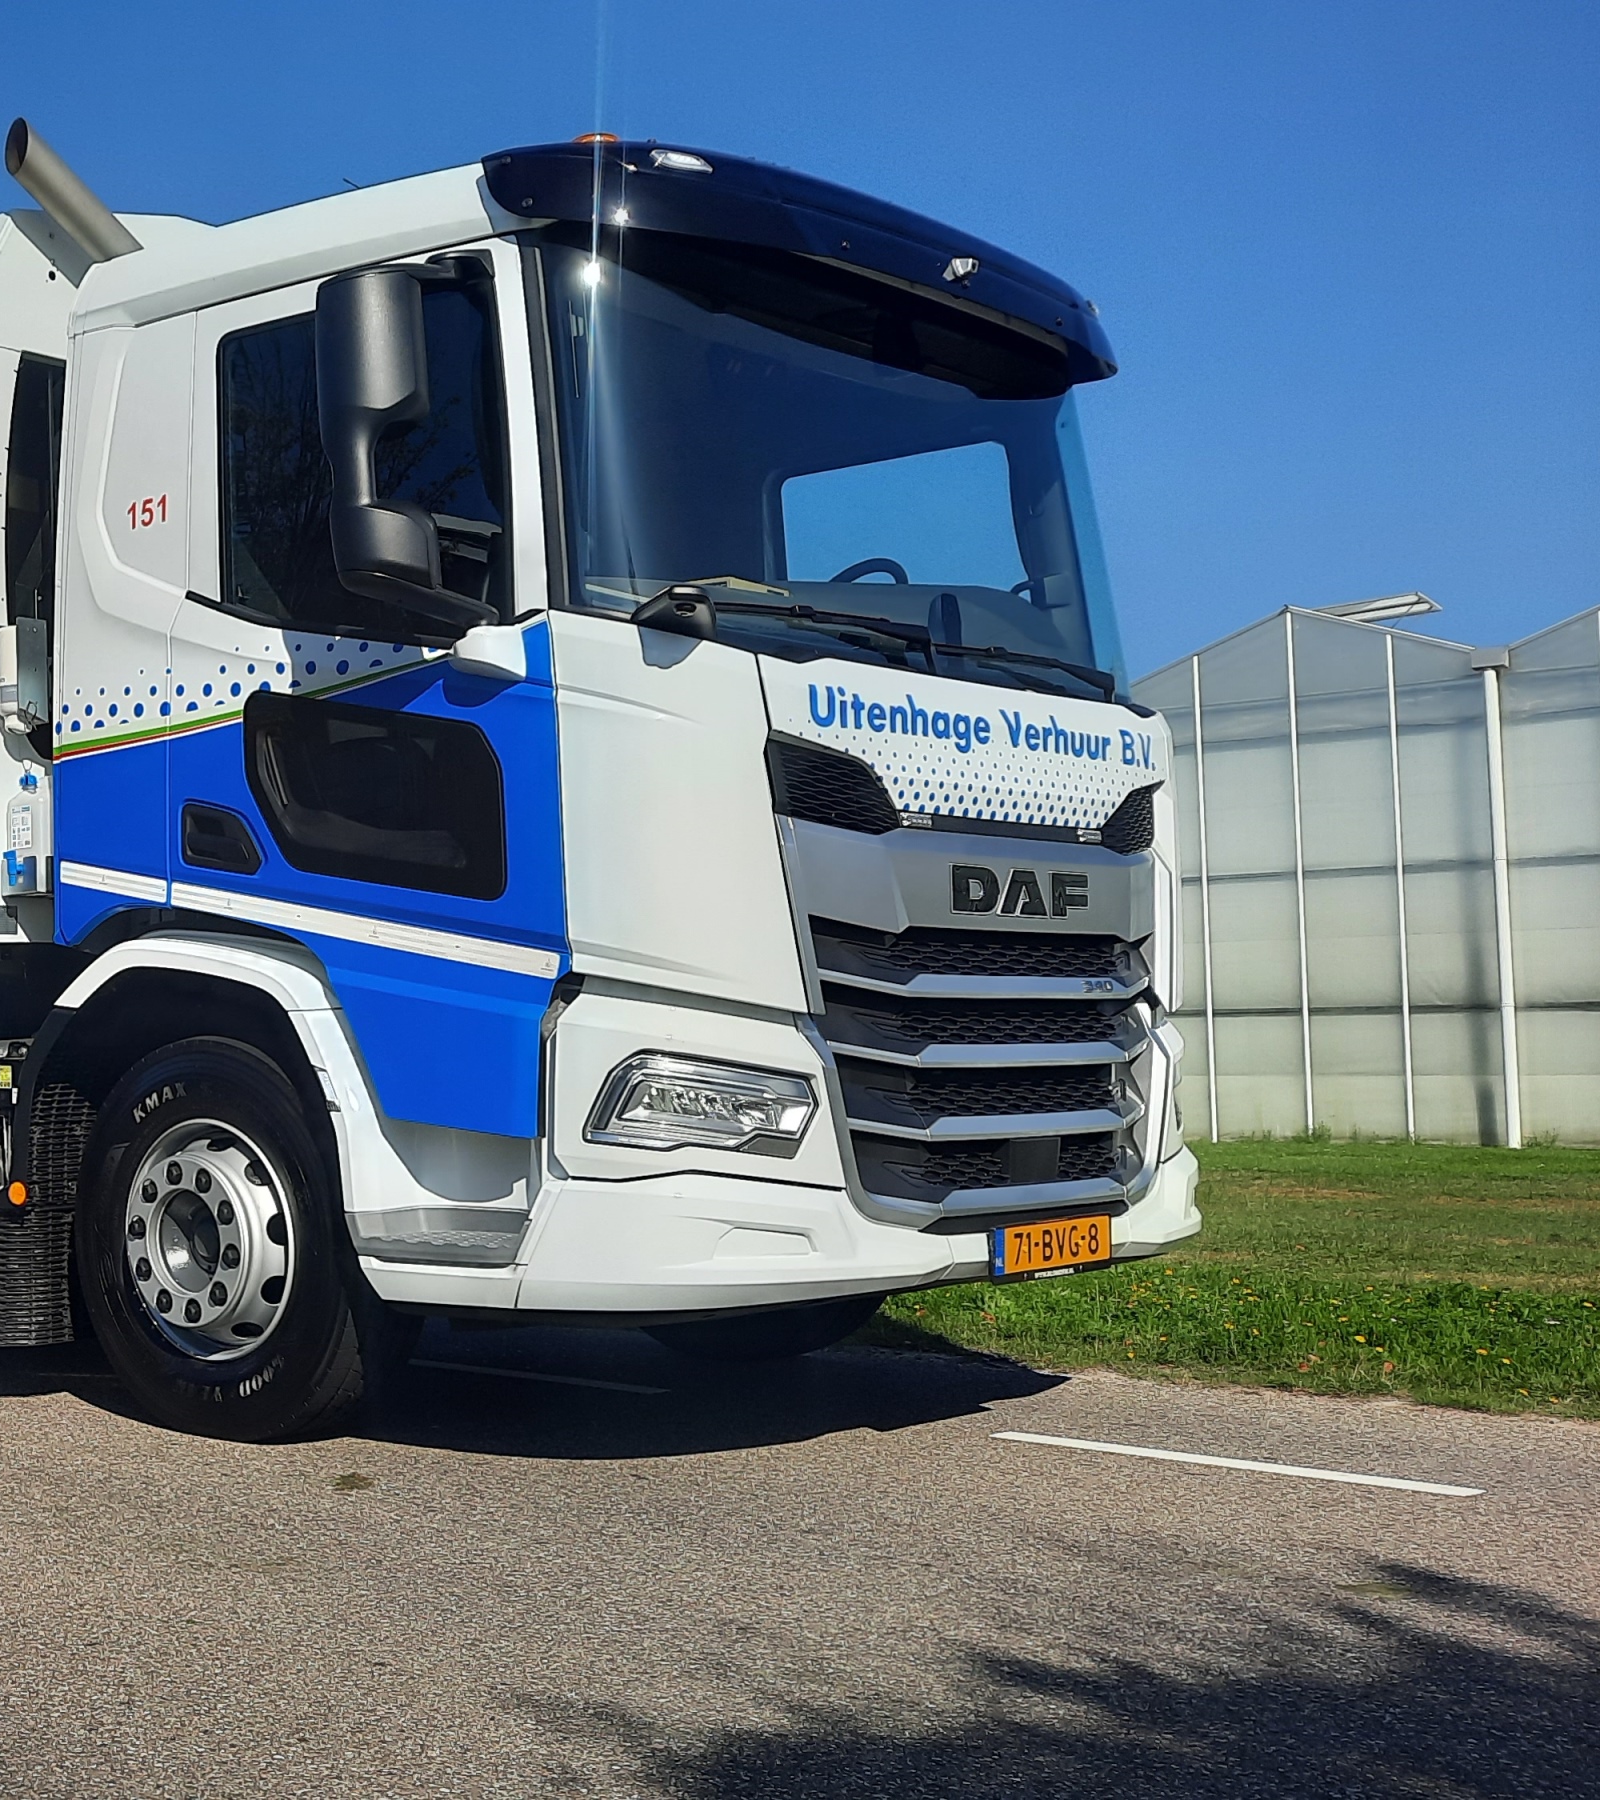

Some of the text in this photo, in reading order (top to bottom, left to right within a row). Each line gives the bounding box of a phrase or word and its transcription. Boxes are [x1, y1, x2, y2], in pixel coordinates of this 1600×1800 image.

[126, 493, 168, 531] 151
[808, 684, 1157, 772] Uitenhage Verhuur B.V.
[949, 863, 1089, 918] DAF
[132, 1081, 187, 1125] KMAX
[1013, 1222, 1100, 1266] 71-BVG-8
